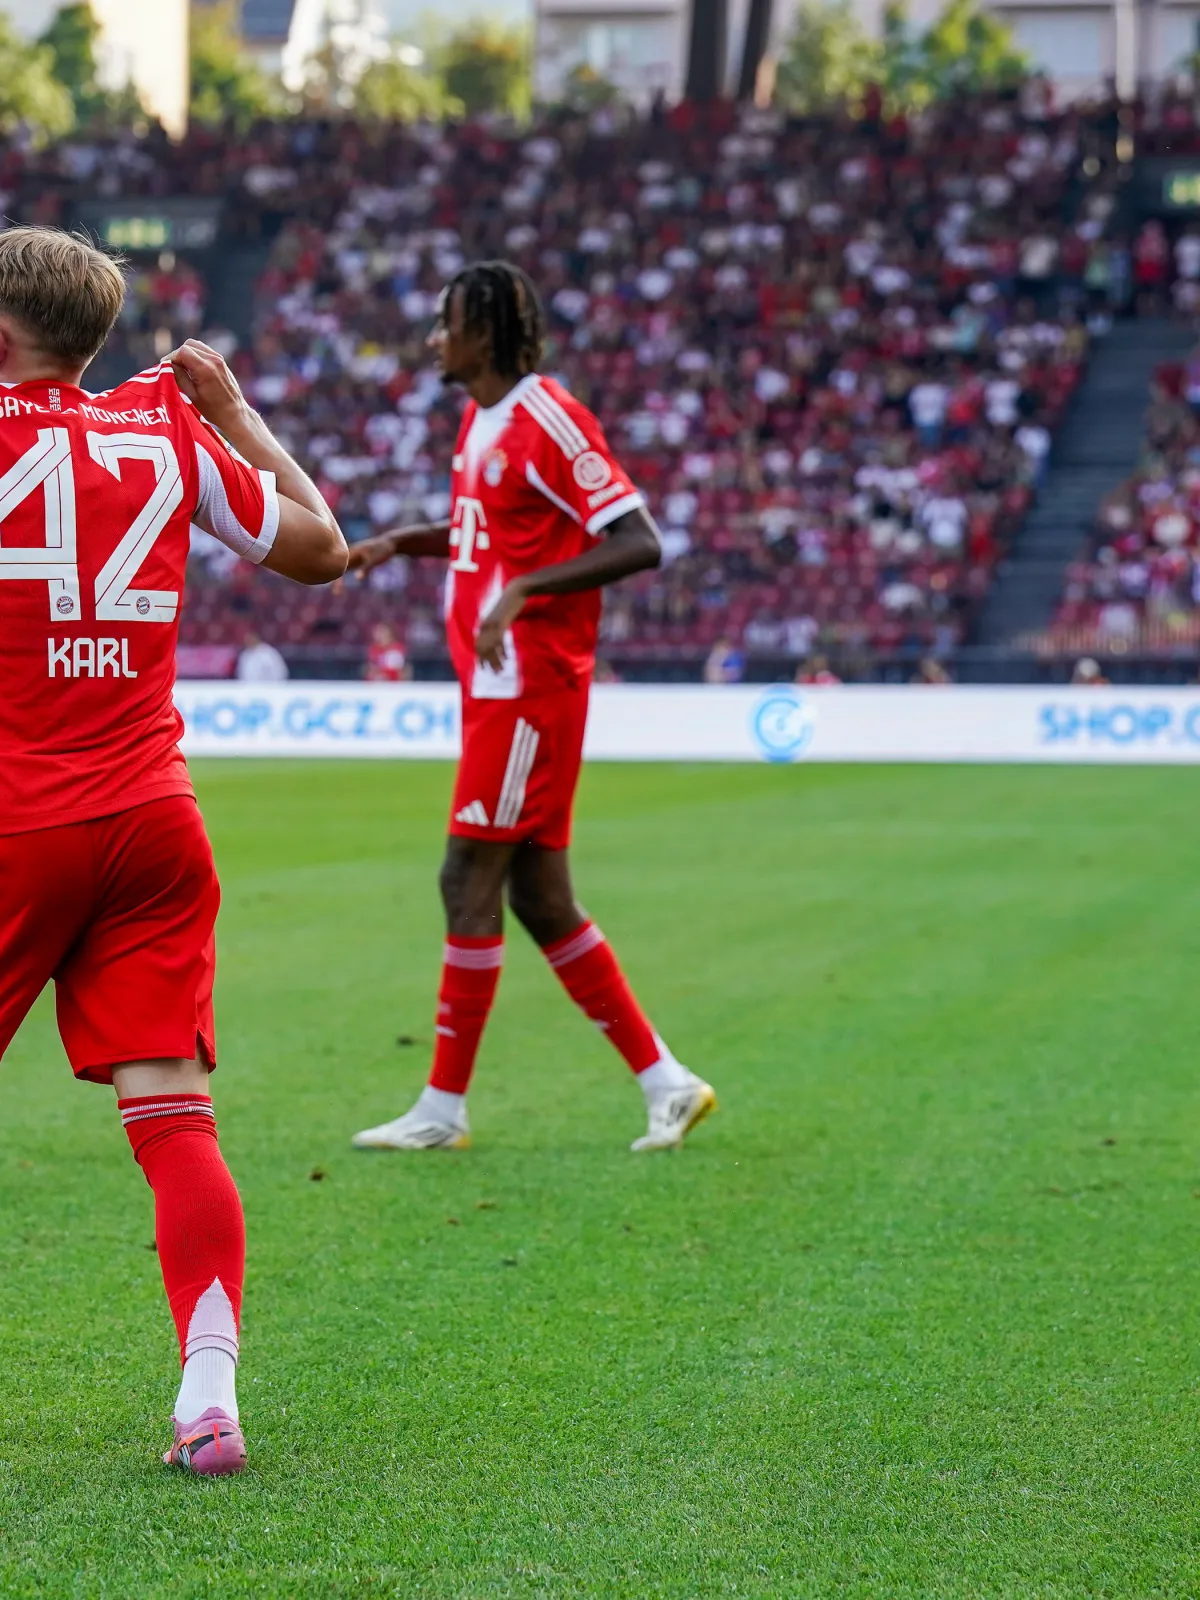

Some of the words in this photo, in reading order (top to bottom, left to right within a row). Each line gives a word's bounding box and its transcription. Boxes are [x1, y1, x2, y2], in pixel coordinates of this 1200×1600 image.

[48, 387, 60, 396] MIA
[50, 403, 62, 412] MIA
[48, 638, 138, 679] KARL
